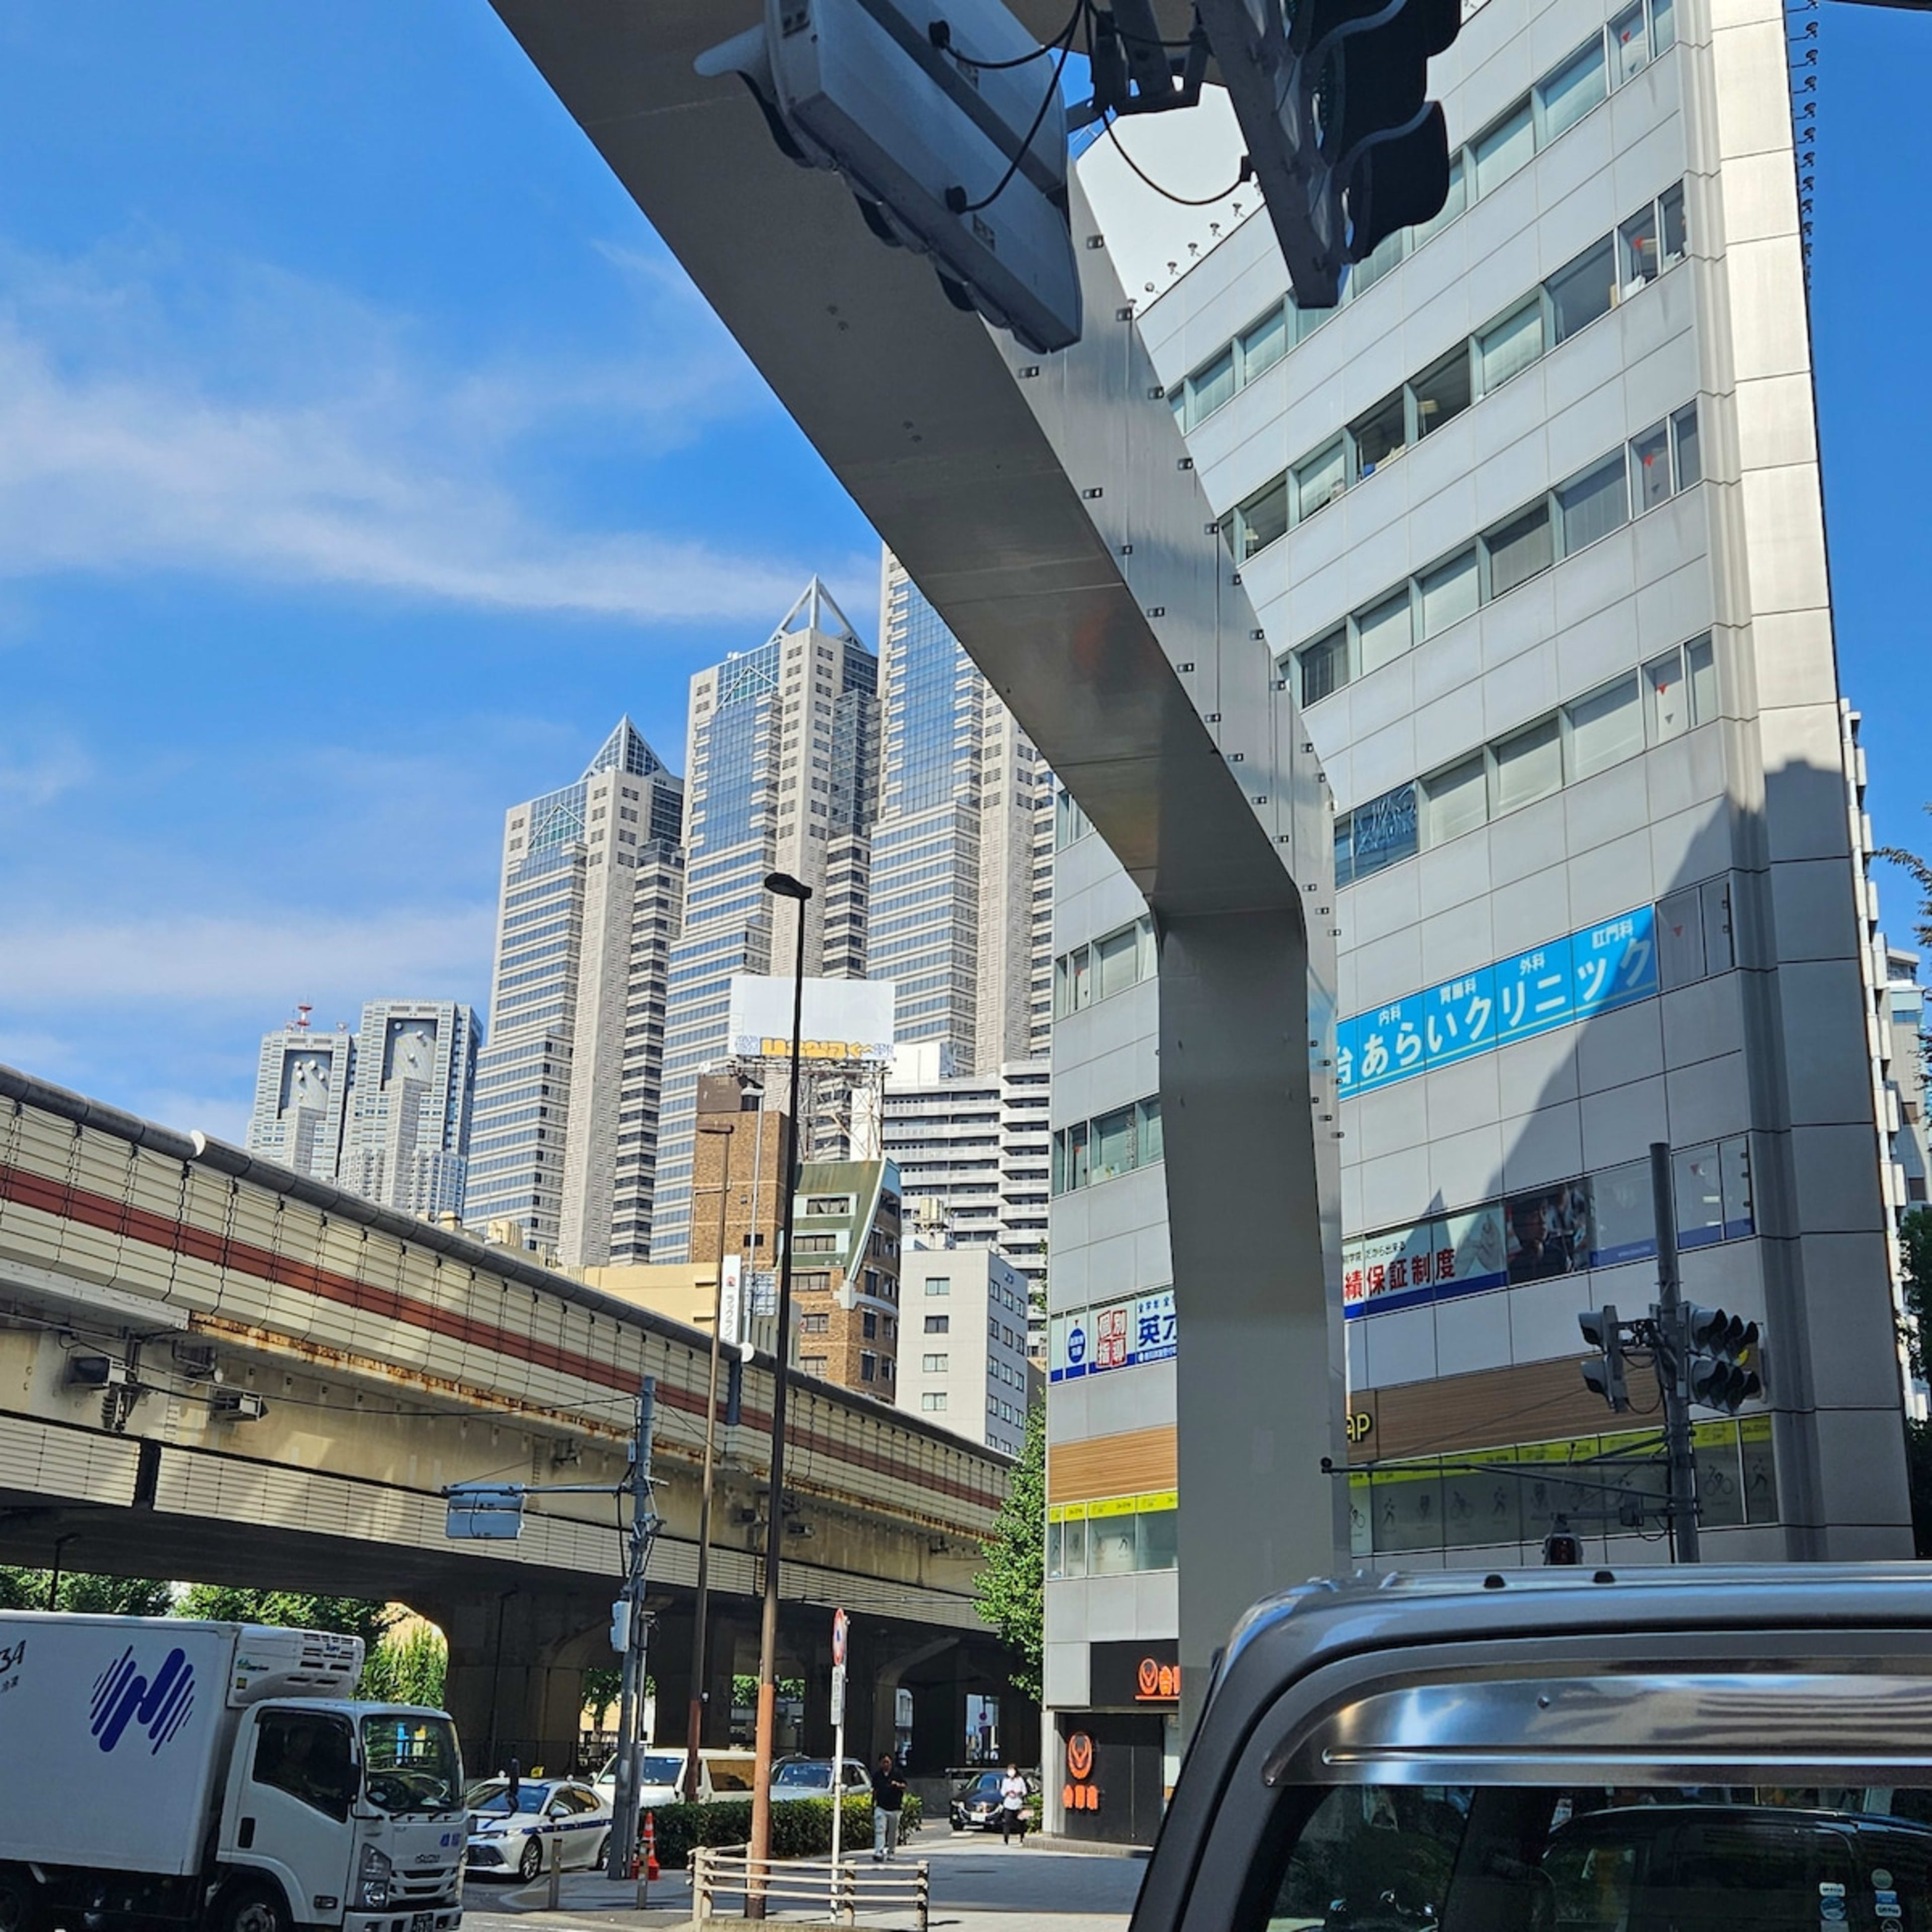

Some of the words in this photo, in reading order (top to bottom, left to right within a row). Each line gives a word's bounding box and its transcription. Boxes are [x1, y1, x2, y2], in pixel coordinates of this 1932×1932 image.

[1379, 1004, 1401, 1027] 内科
[1440, 978, 1477, 1005] 胃腸科
[1519, 952, 1546, 976] 外科
[1592, 918, 1634, 949] 肛門科
